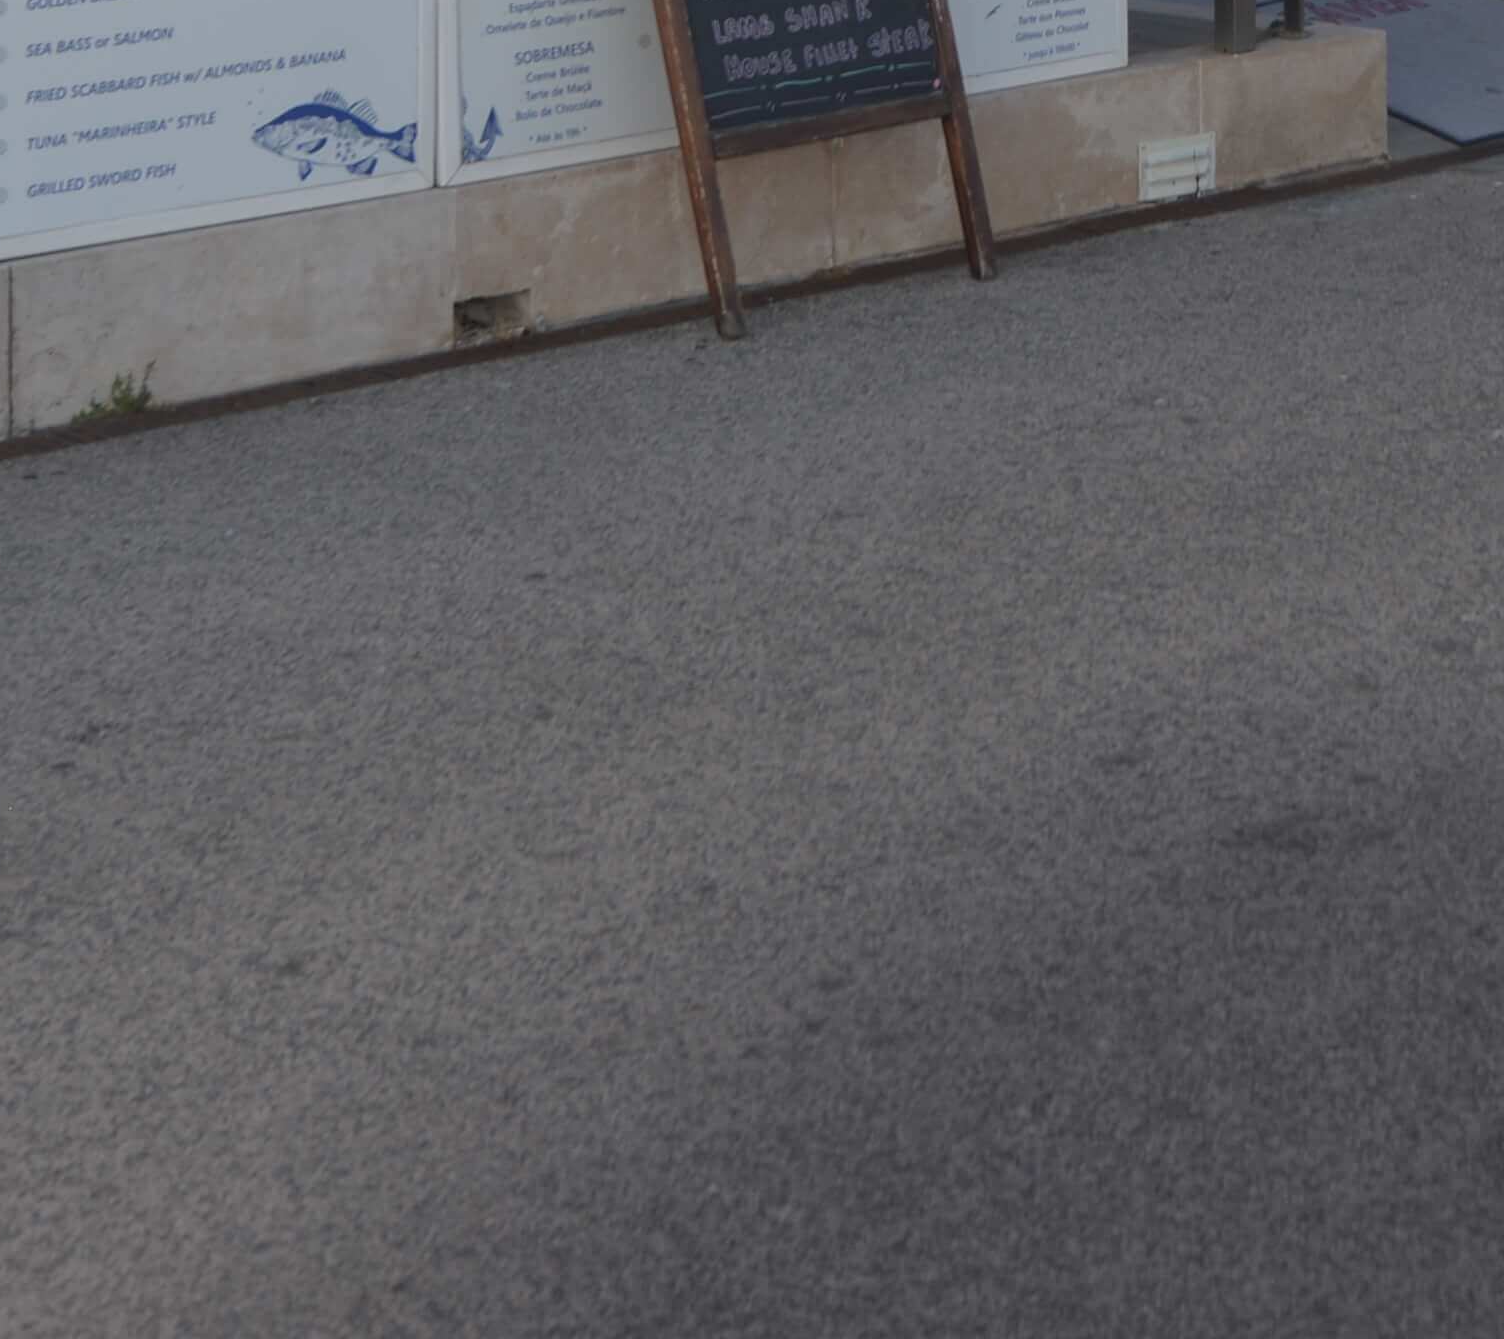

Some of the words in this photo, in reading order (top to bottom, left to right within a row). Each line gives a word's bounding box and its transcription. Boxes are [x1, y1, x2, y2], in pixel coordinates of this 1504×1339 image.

[25, 42, 52, 58] SEA
[56, 36, 92, 54] BASS
[113, 27, 174, 46] SALMON
[27, 177, 86, 198] GRILLED
[88, 167, 143, 189] SWORD
[144, 163, 176, 180] FISH
